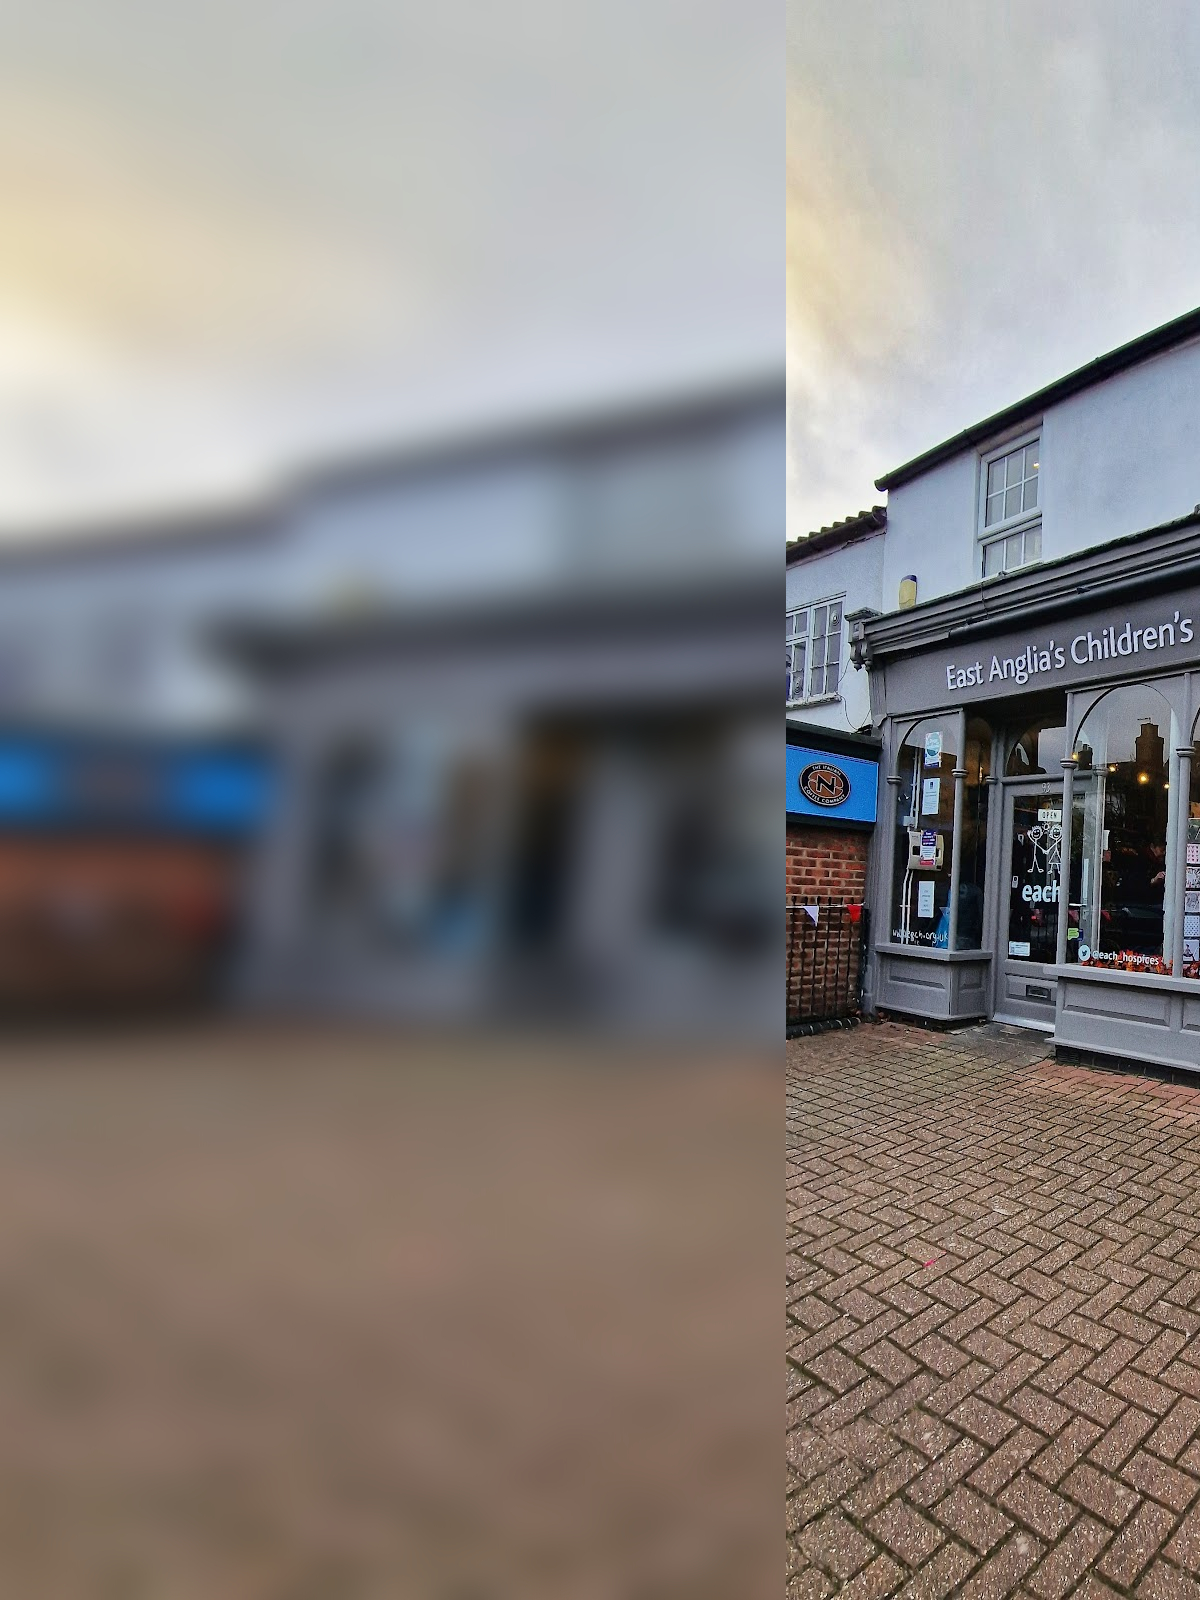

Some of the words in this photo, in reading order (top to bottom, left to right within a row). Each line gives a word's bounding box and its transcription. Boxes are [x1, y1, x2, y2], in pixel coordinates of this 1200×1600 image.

[946, 661, 984, 691] East
[989, 639, 1065, 685] Anglia's
[1071, 611, 1194, 664] Children's
[823, 765, 842, 776] ITALIAN
[803, 785, 820, 802] COFFEE
[821, 793, 846, 804] COMPANY
[1042, 811, 1058, 820] OPEN
[1022, 880, 1060, 902] each
[1092, 950, 1159, 965] @each_hospices
